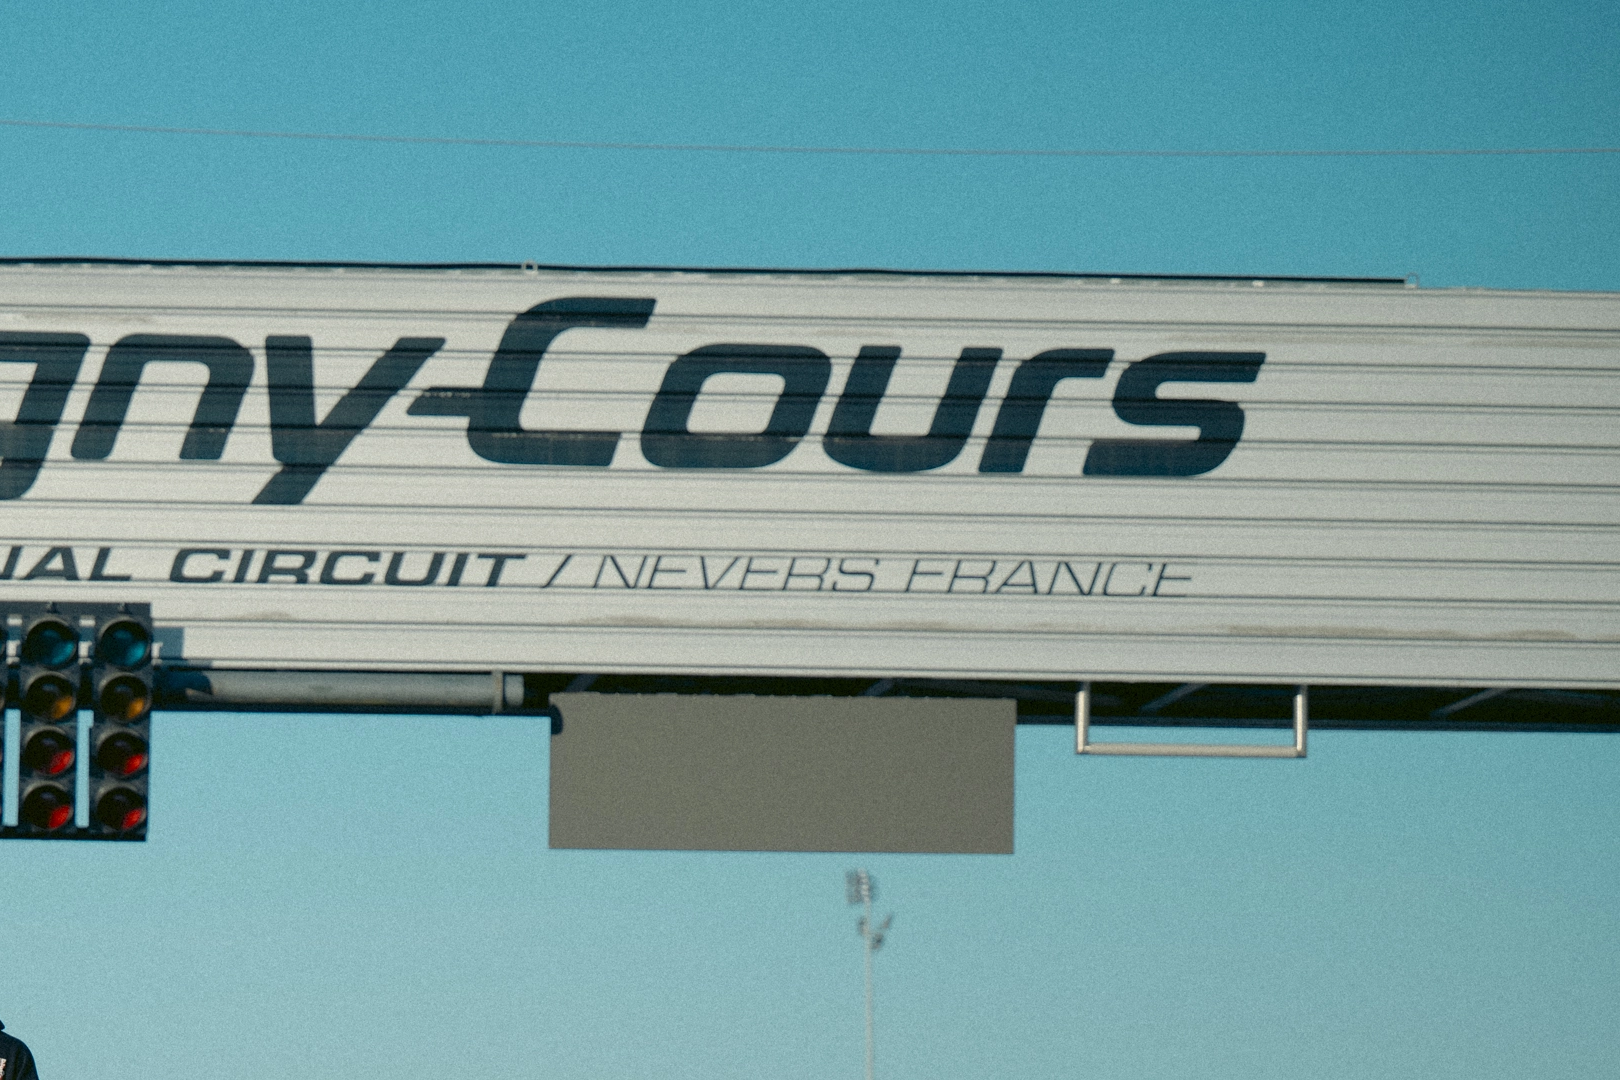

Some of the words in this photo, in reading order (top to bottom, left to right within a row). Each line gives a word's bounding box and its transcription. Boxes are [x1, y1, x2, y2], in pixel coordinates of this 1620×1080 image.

[169, 547, 527, 588] CIRCUIT
[539, 554, 573, 589] /
[593, 555, 880, 592] NEVERS
[905, 558, 1193, 598] FRANCE
